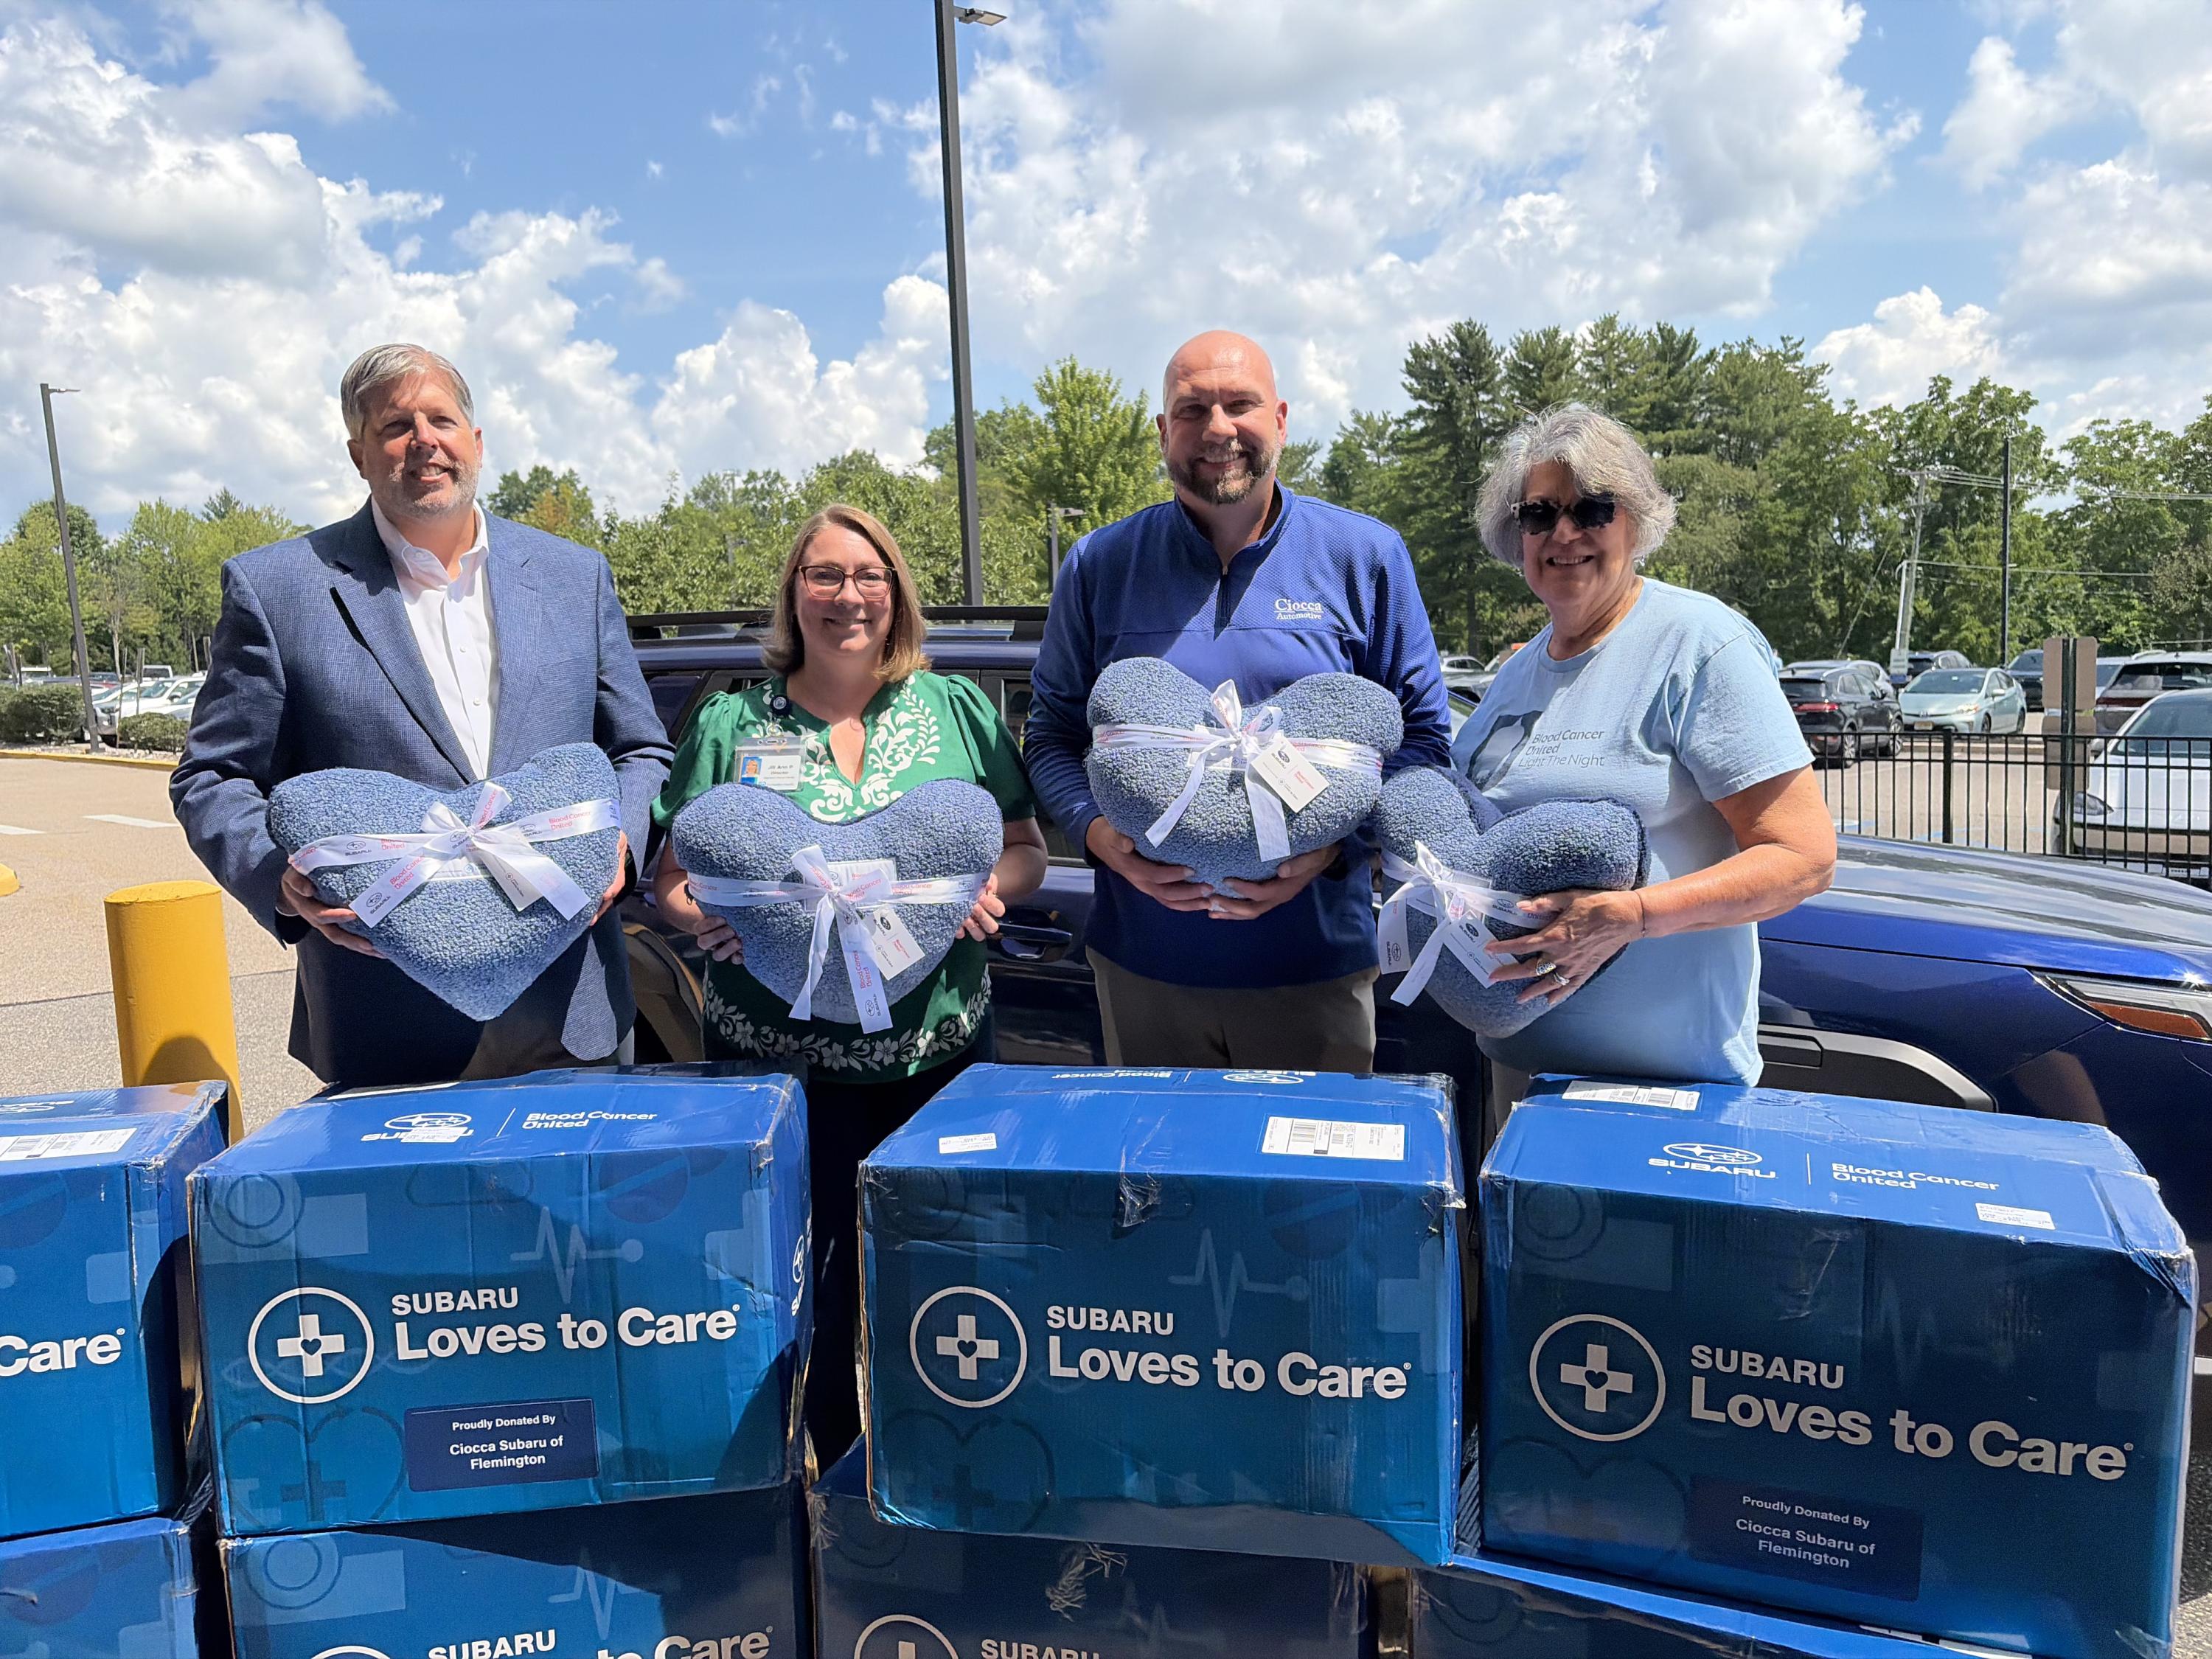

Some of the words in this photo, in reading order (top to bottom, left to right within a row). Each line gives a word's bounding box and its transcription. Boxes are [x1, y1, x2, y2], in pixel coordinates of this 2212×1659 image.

[1275, 598, 1322, 611] Ciocca
[1276, 612, 1322, 620] Automotive
[1532, 731, 1562, 744] Blood
[1562, 729, 1604, 740] Cancer
[1526, 742, 1561, 756] United
[1518, 755, 1546, 770] Light
[1548, 755, 1567, 767] The
[1568, 754, 1605, 768] Night
[549, 814, 569, 824] Blood
[389, 868, 407, 885] Blood
[369, 895, 392, 915] SUBARU
[1492, 904, 1518, 916] SUBARU
[858, 971, 866, 990] Blood
[521, 1119, 590, 1130] United
[527, 1111, 586, 1122] Blood
[587, 1110, 658, 1121] Cancer
[1648, 1157, 1776, 1179] SUBARU
[1832, 1162, 1907, 1181] Blood
[1907, 1172, 2000, 1191] Cancer
[1832, 1171, 1917, 1190] United
[392, 1287, 518, 1315] SUBARU
[1046, 1305, 1174, 1335] SUBARU
[395, 1321, 546, 1360] Loves
[557, 1312, 608, 1350] to
[1048, 1335, 1200, 1387] Loves
[1212, 1349, 1266, 1391] to
[1691, 1344, 1844, 1389] SUBARU
[452, 1419, 493, 1431] Proudly
[495, 1416, 540, 1427] Donated
[542, 1414, 556, 1425] By
[1691, 1375, 1872, 1445] Loves
[1889, 1408, 1954, 1458] to
[449, 1442, 496, 1455] Ciocca
[499, 1436, 547, 1451] Subaru
[549, 1435, 564, 1447] of
[470, 1454, 546, 1470] Flemington
[1742, 1495, 1792, 1515] Proudly
[1794, 1505, 1850, 1524] Donated
[1852, 1515, 1871, 1530] By
[1735, 1518, 1792, 1540] Ciocca
[1795, 1529, 1854, 1552] Subaru
[1858, 1543, 1877, 1556] of
[1758, 1539, 1851, 1569] Flemington
